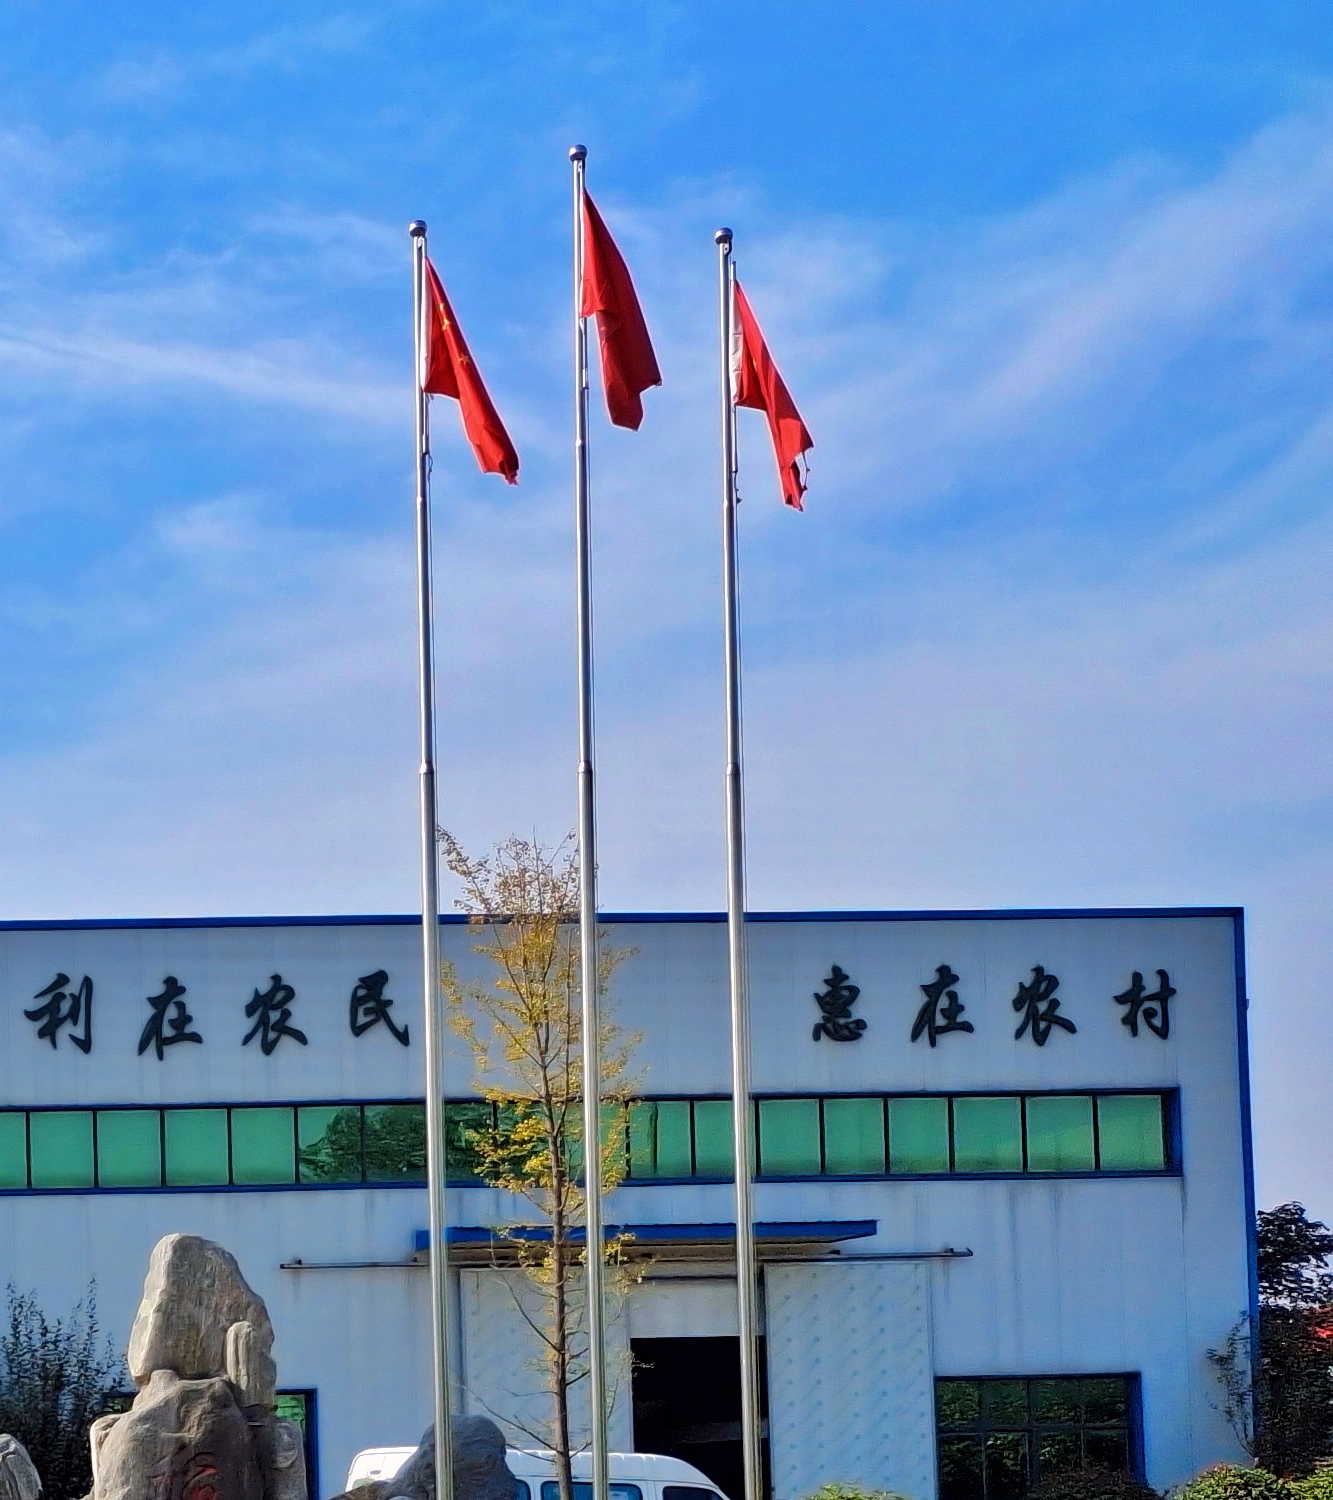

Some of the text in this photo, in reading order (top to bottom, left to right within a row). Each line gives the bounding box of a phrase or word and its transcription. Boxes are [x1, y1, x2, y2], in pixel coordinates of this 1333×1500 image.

[23, 968, 410, 1062] 利在农民
[811, 963, 1178, 1049] 惠在农村
